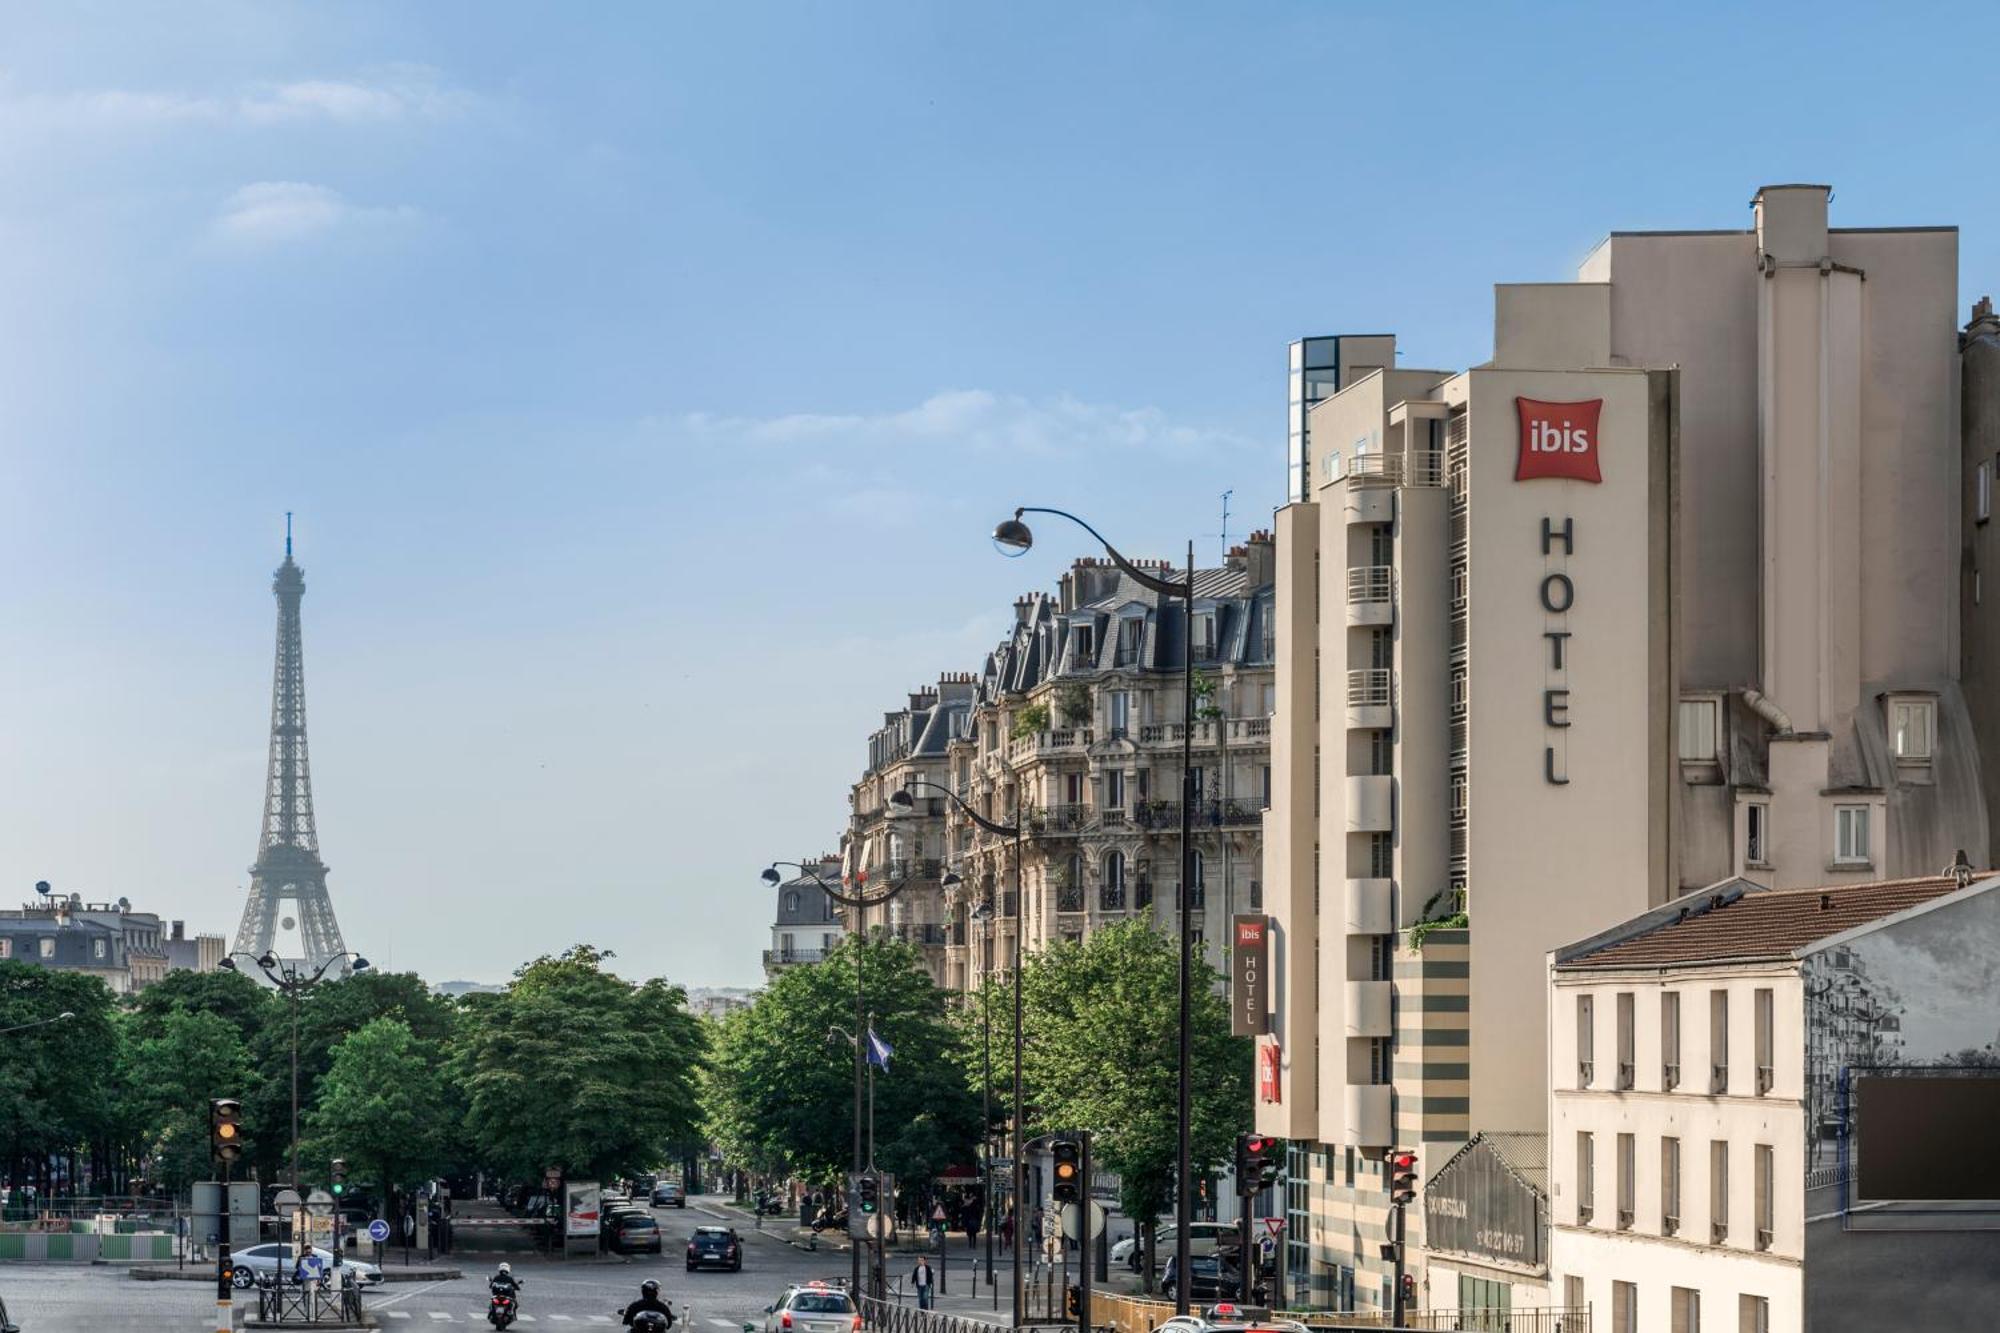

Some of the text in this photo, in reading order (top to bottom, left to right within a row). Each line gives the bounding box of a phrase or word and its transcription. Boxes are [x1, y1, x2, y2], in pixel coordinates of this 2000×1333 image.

[1531, 420, 1589, 453] ibis
[1540, 517, 1574, 785] HOTEL
[1241, 927, 1260, 940] ibis
[1245, 956, 1256, 1025] HOTEL
